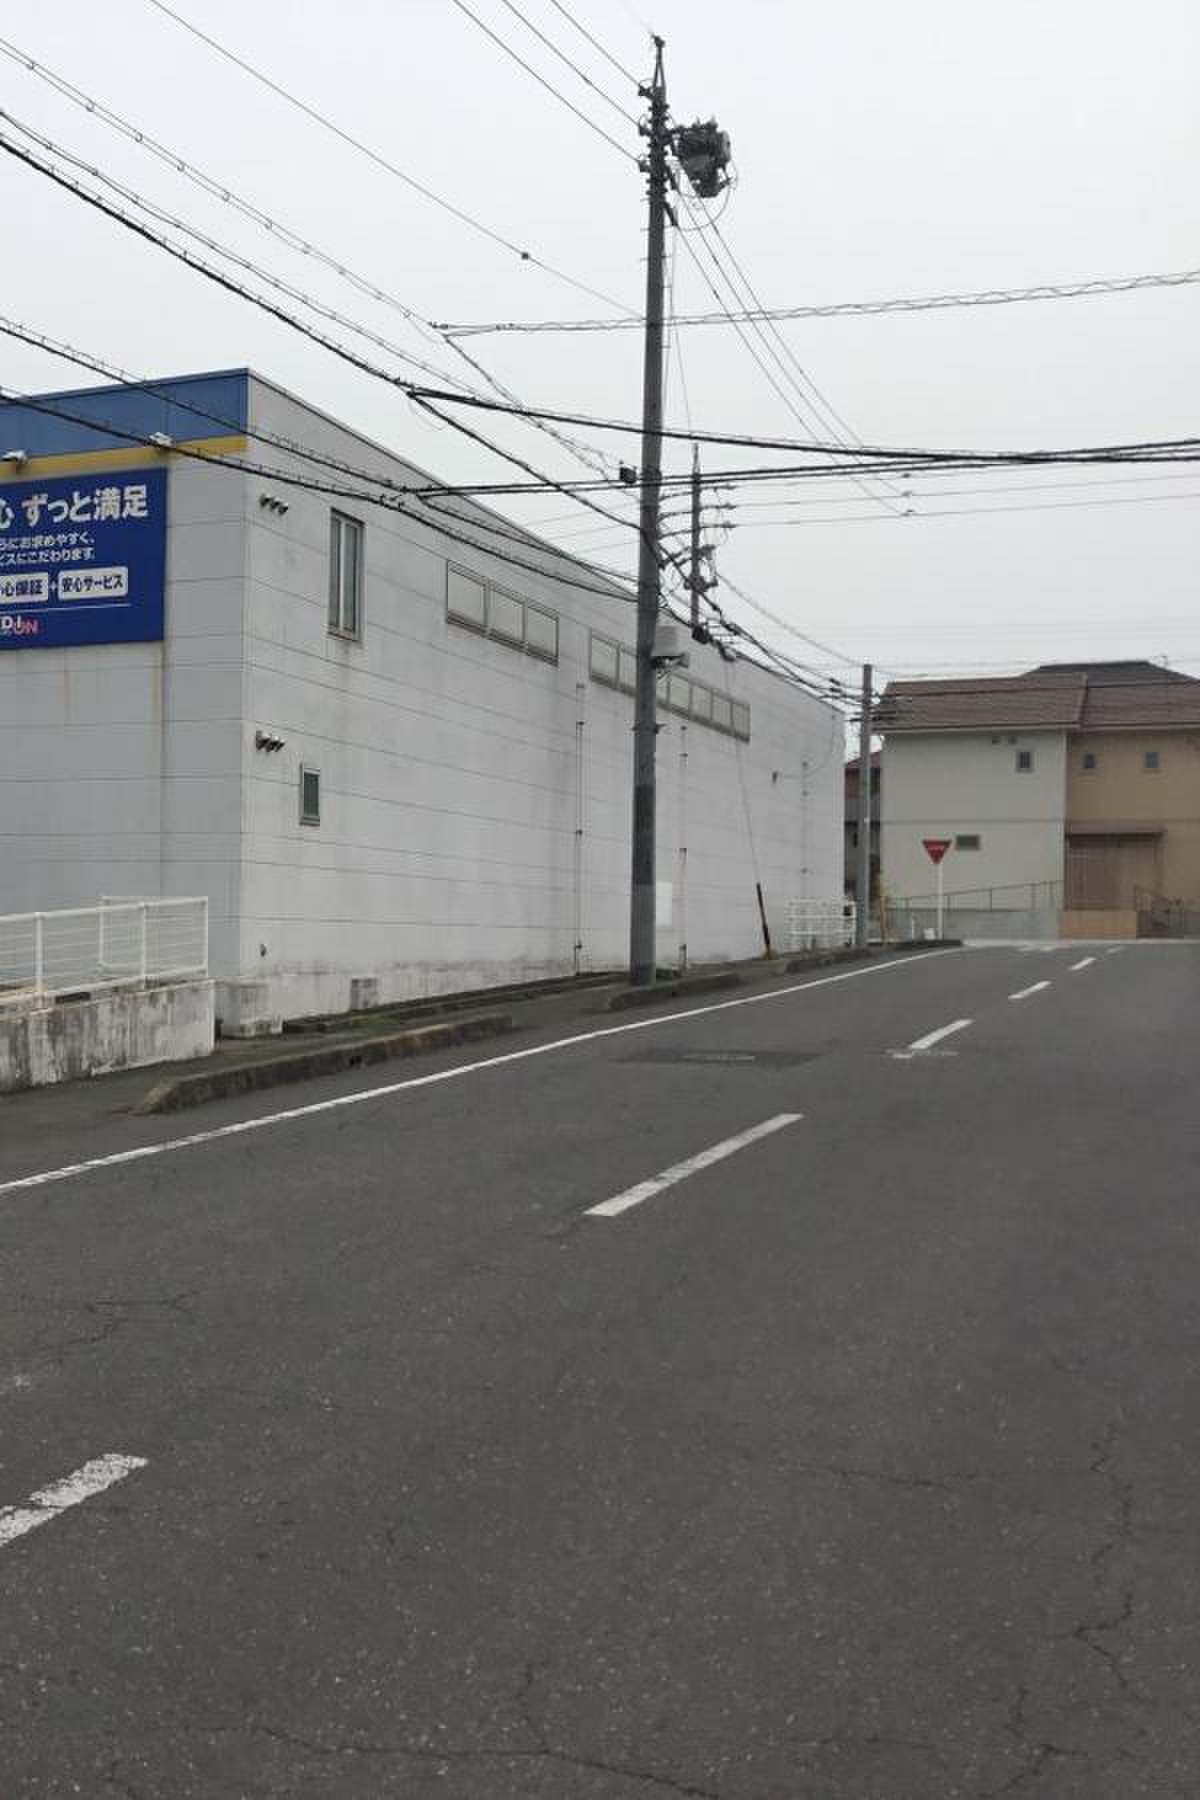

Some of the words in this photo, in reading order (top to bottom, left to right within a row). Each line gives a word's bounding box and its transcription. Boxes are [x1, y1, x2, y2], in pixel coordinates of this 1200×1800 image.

[22, 485, 148, 527] ずっと満足
[62, 574, 124, 593] 安心サービス
